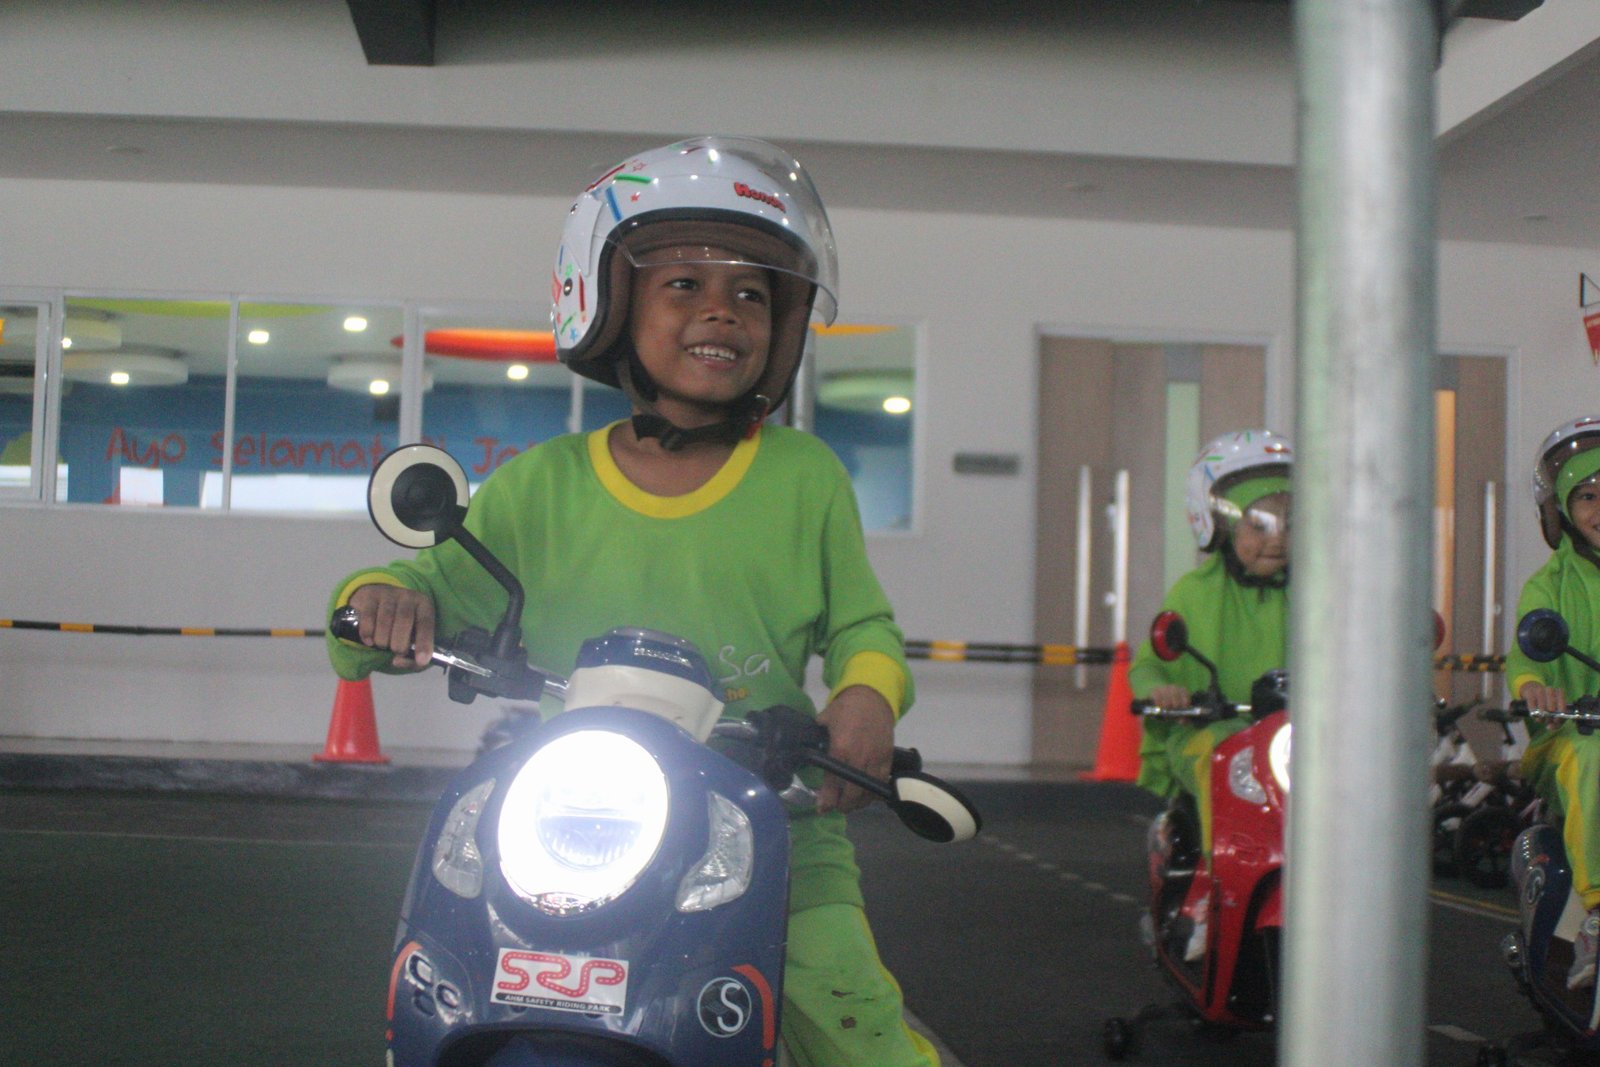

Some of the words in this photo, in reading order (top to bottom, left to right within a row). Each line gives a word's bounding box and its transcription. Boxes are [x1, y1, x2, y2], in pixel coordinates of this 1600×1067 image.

[103, 426, 187, 470] Ayo
[497, 951, 626, 998] SRP
[526, 997, 554, 1006] SAFETY
[556, 1000, 586, 1010] RIDING
[587, 1004, 611, 1013] PARK
